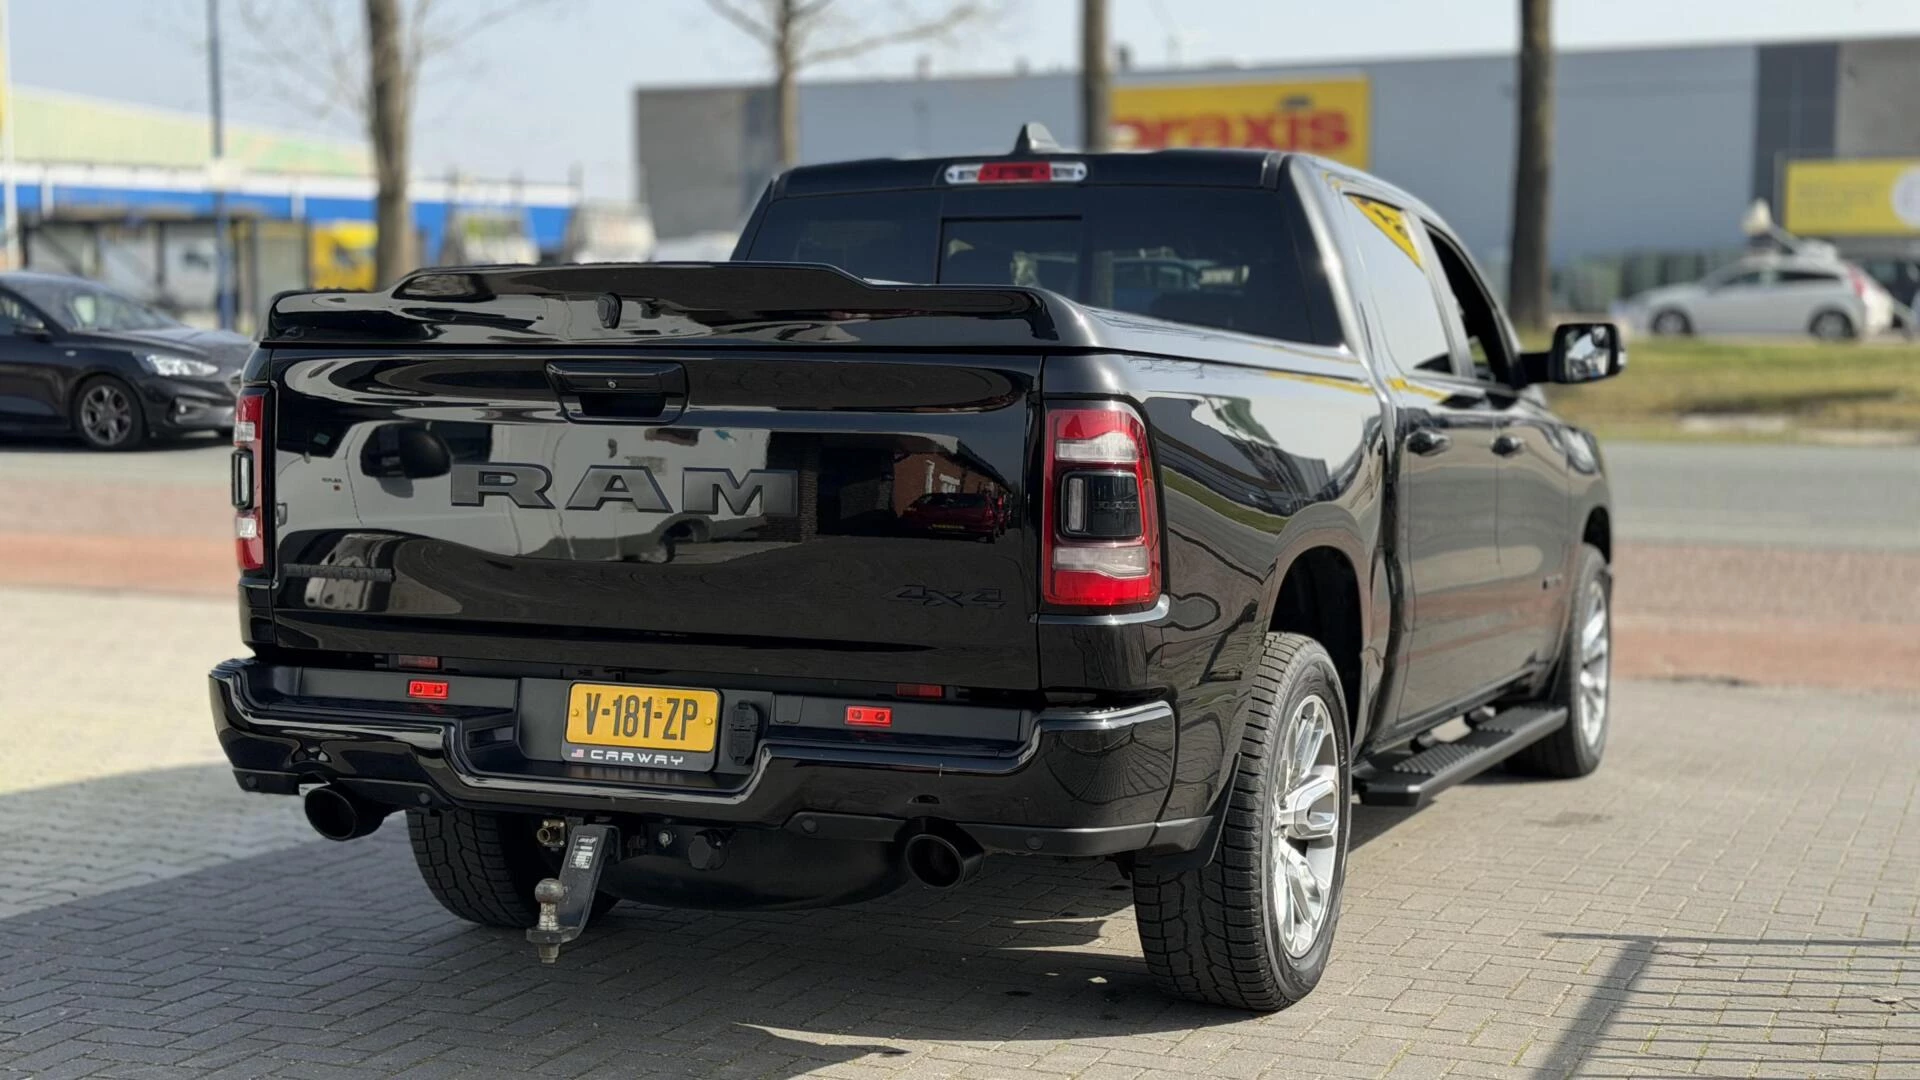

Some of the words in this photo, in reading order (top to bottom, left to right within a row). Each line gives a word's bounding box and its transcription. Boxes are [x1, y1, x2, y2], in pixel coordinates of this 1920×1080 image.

[450, 462, 798, 517] RAM
[586, 692, 698, 741] V-181-ZP
[590, 750, 684, 765] CARWAY
